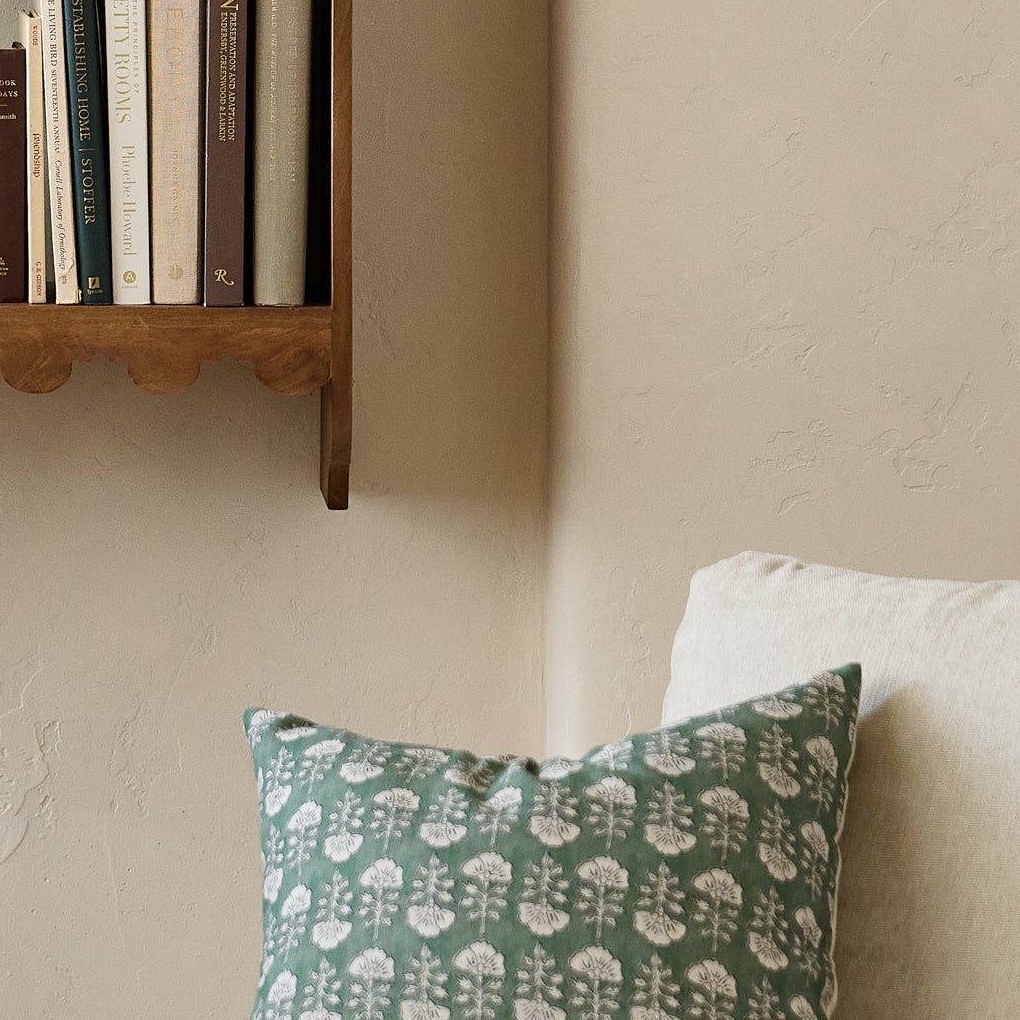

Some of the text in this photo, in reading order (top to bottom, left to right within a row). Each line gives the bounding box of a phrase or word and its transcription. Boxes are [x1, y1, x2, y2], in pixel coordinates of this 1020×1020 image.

[48, 8, 57, 41] LIVING
[219, 12, 228, 54] ENDERSBY,
[49, 44, 58, 66] BIRD
[219, 55, 228, 104] GREENWOOD
[227, 12, 238, 141] PRESERVATION AND ADAPTATION
[51, 70, 60, 122] SEVENTEENTH
[114, 54, 132, 124] ROOMS
[133, 84, 140, 94] OF
[77, 98, 91, 141] HOME
[218, 112, 227, 141] LARKIN
[54, 160, 68, 271] Cornell Laboratory of Ornithology
[81, 158, 96, 225] STOFFER
[121, 146, 137, 256] Phoebe Howard
